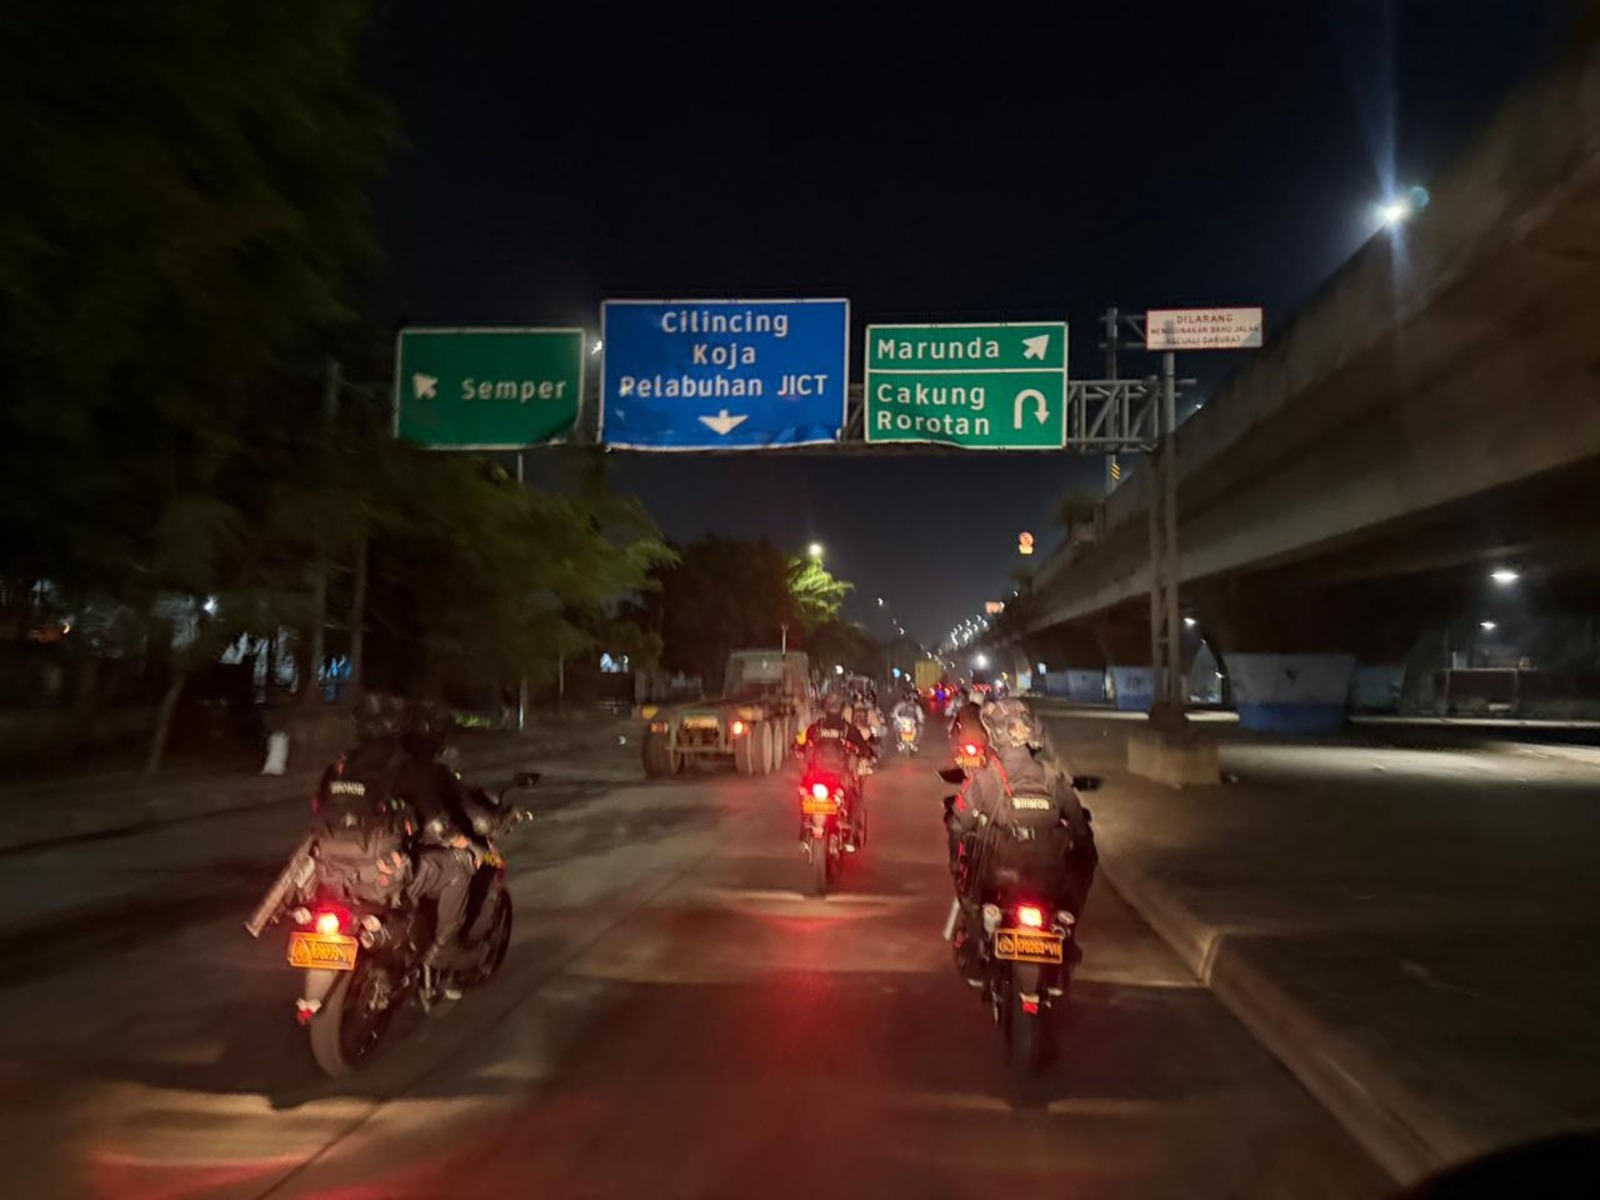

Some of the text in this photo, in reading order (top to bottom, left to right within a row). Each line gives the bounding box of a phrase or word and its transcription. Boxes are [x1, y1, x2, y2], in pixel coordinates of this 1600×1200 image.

[661, 313, 788, 337] Cilincing
[1177, 314, 1233, 323] DILARANG
[693, 343, 756, 369] Koja
[878, 337, 1000, 360] Marunda
[461, 378, 567, 403] Semper
[619, 375, 827, 397] Pelabuhan JICT
[877, 383, 985, 410] Cakung
[877, 411, 990, 436] Rorotan
